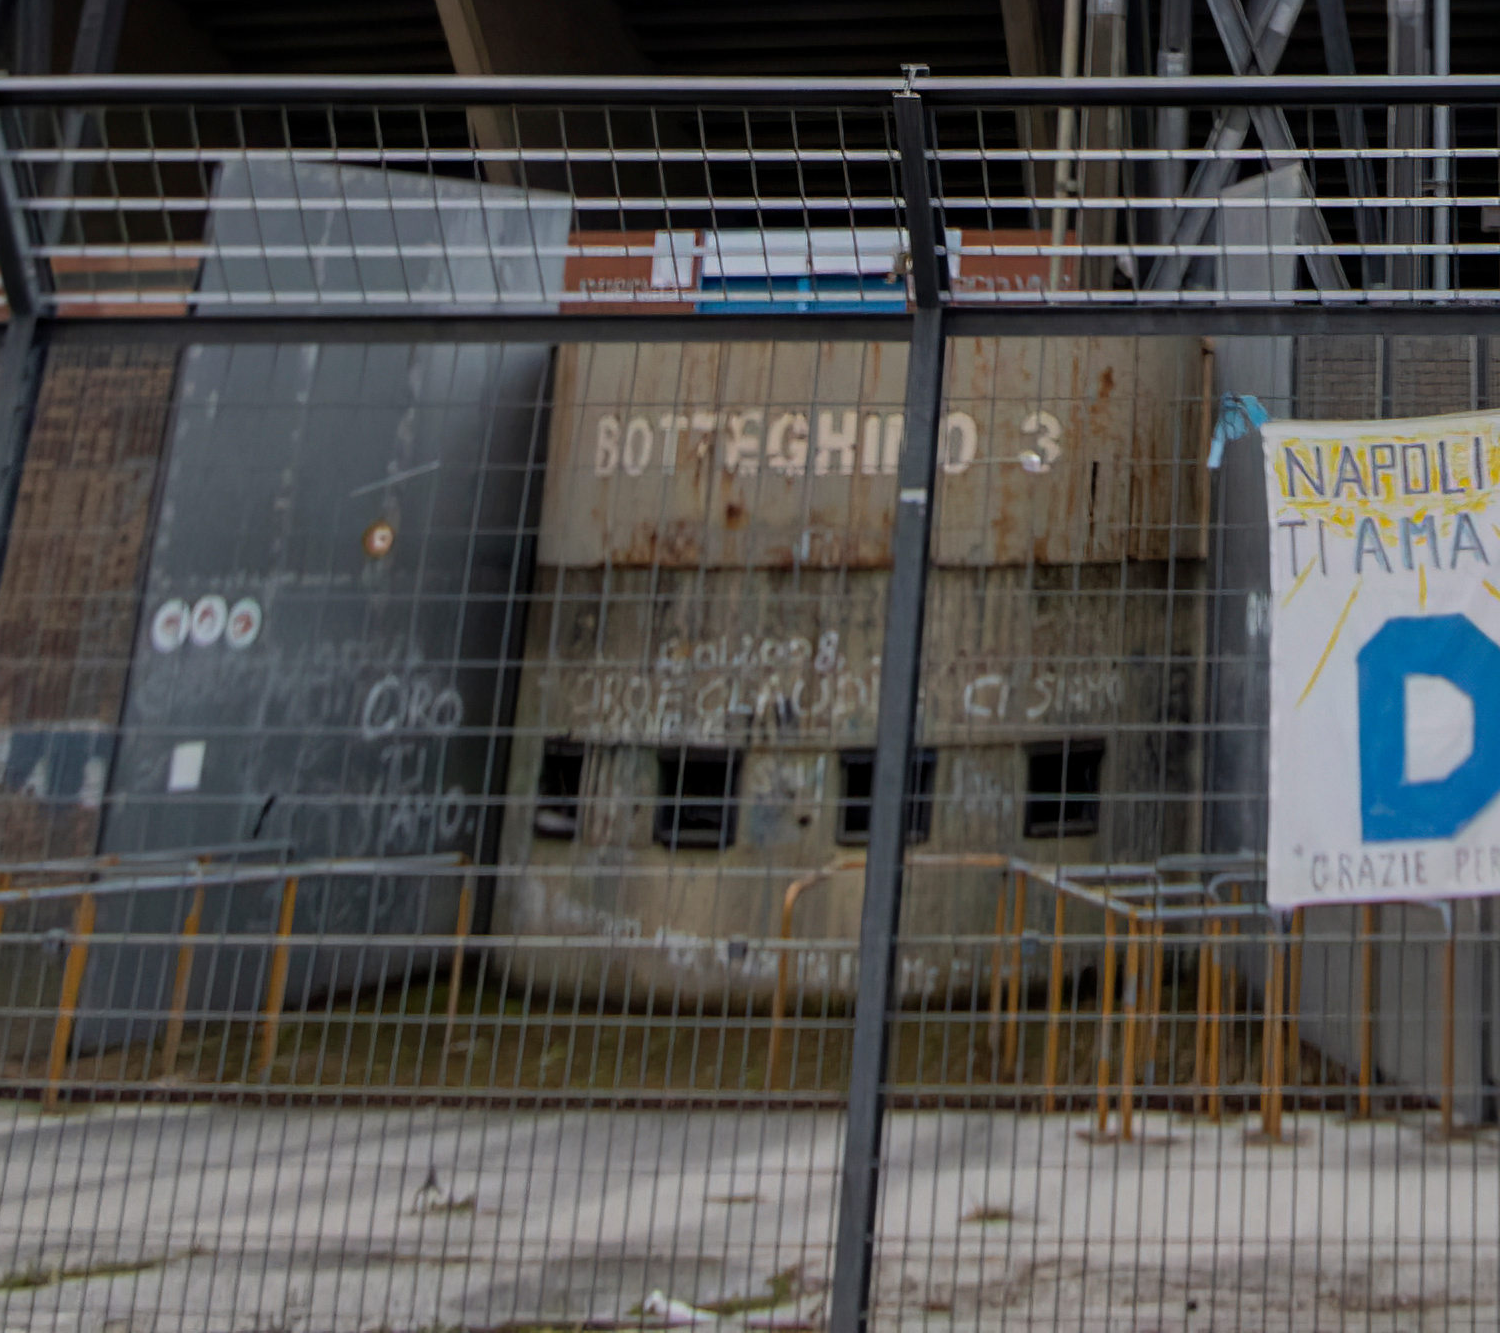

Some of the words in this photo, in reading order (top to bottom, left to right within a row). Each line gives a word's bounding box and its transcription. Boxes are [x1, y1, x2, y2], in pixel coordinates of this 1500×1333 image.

[1021, 410, 1065, 475] 3
[1284, 435, 1485, 498] NAPOLI
[1278, 519, 1329, 577] TI
[1354, 512, 1490, 574] AMA
